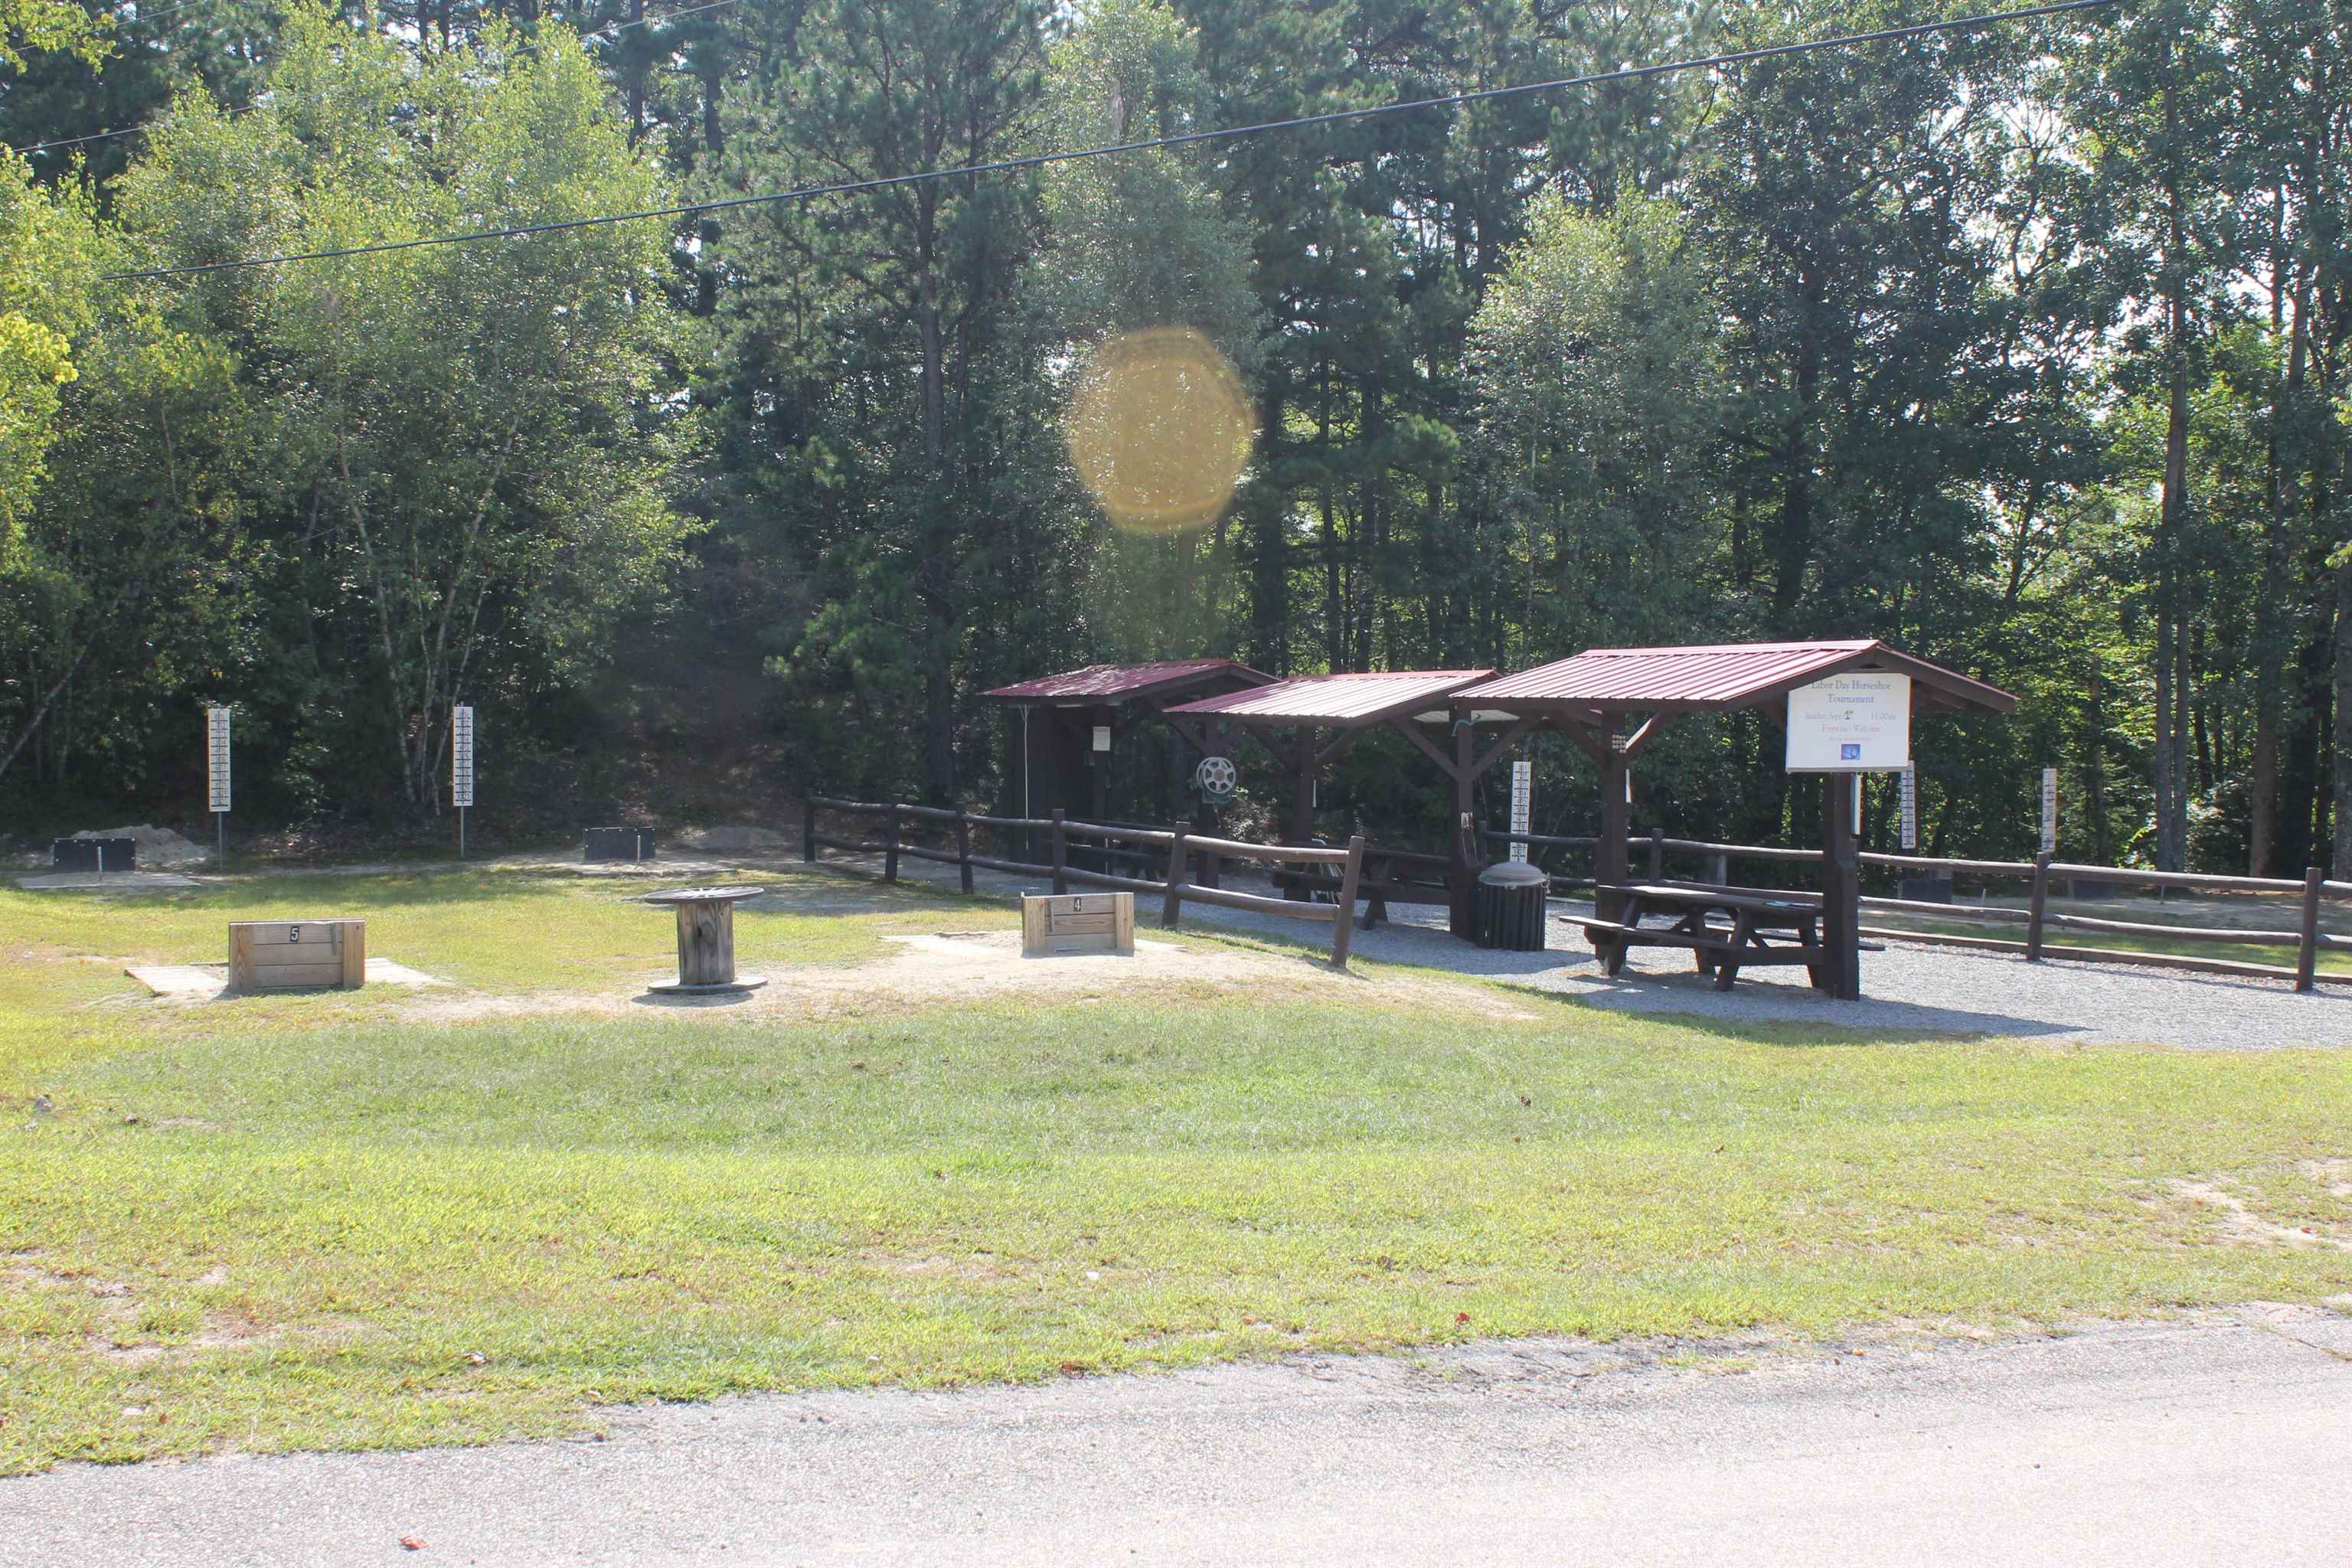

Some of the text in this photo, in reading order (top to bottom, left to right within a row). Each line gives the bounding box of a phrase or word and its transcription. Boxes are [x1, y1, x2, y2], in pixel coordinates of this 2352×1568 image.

[1811, 680, 1892, 691] Labor Day Horseshoe
[1827, 694, 1874, 704] Tournament
[1074, 898, 1081, 911] 4
[291, 926, 299, 941] 5
